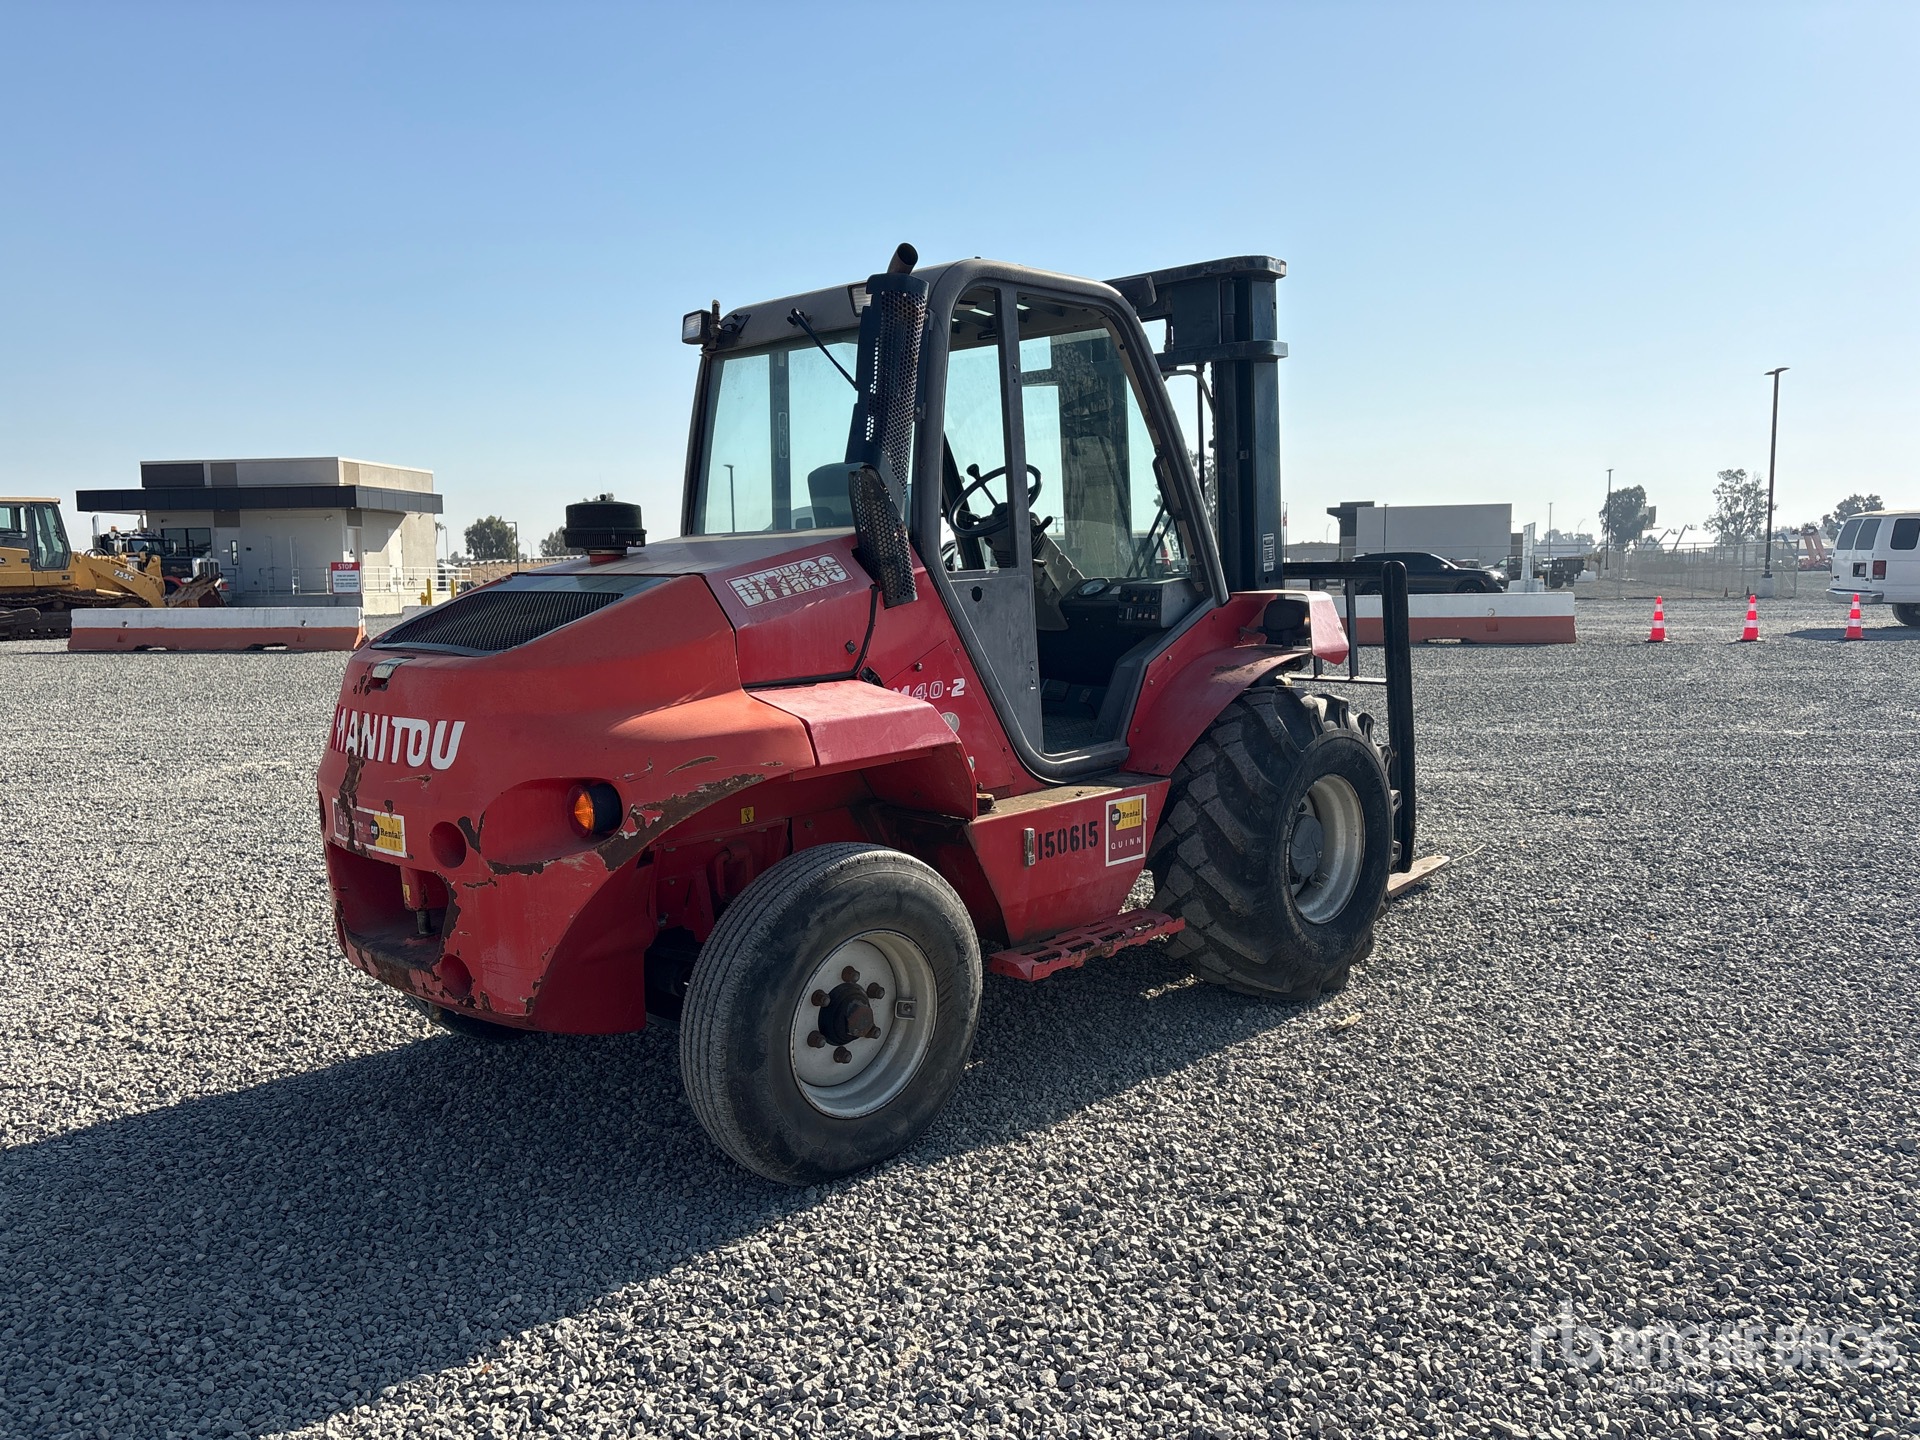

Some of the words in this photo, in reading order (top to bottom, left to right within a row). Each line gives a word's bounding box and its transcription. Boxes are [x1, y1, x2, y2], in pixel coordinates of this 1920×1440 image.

[114, 569, 135, 582] 755C
[334, 706, 466, 770] MANITOU
[1121, 808, 1141, 820] Rental
[380, 827, 402, 840] Rental
[1037, 820, 1099, 860] 150615
[1110, 836, 1142, 850] QUINN
